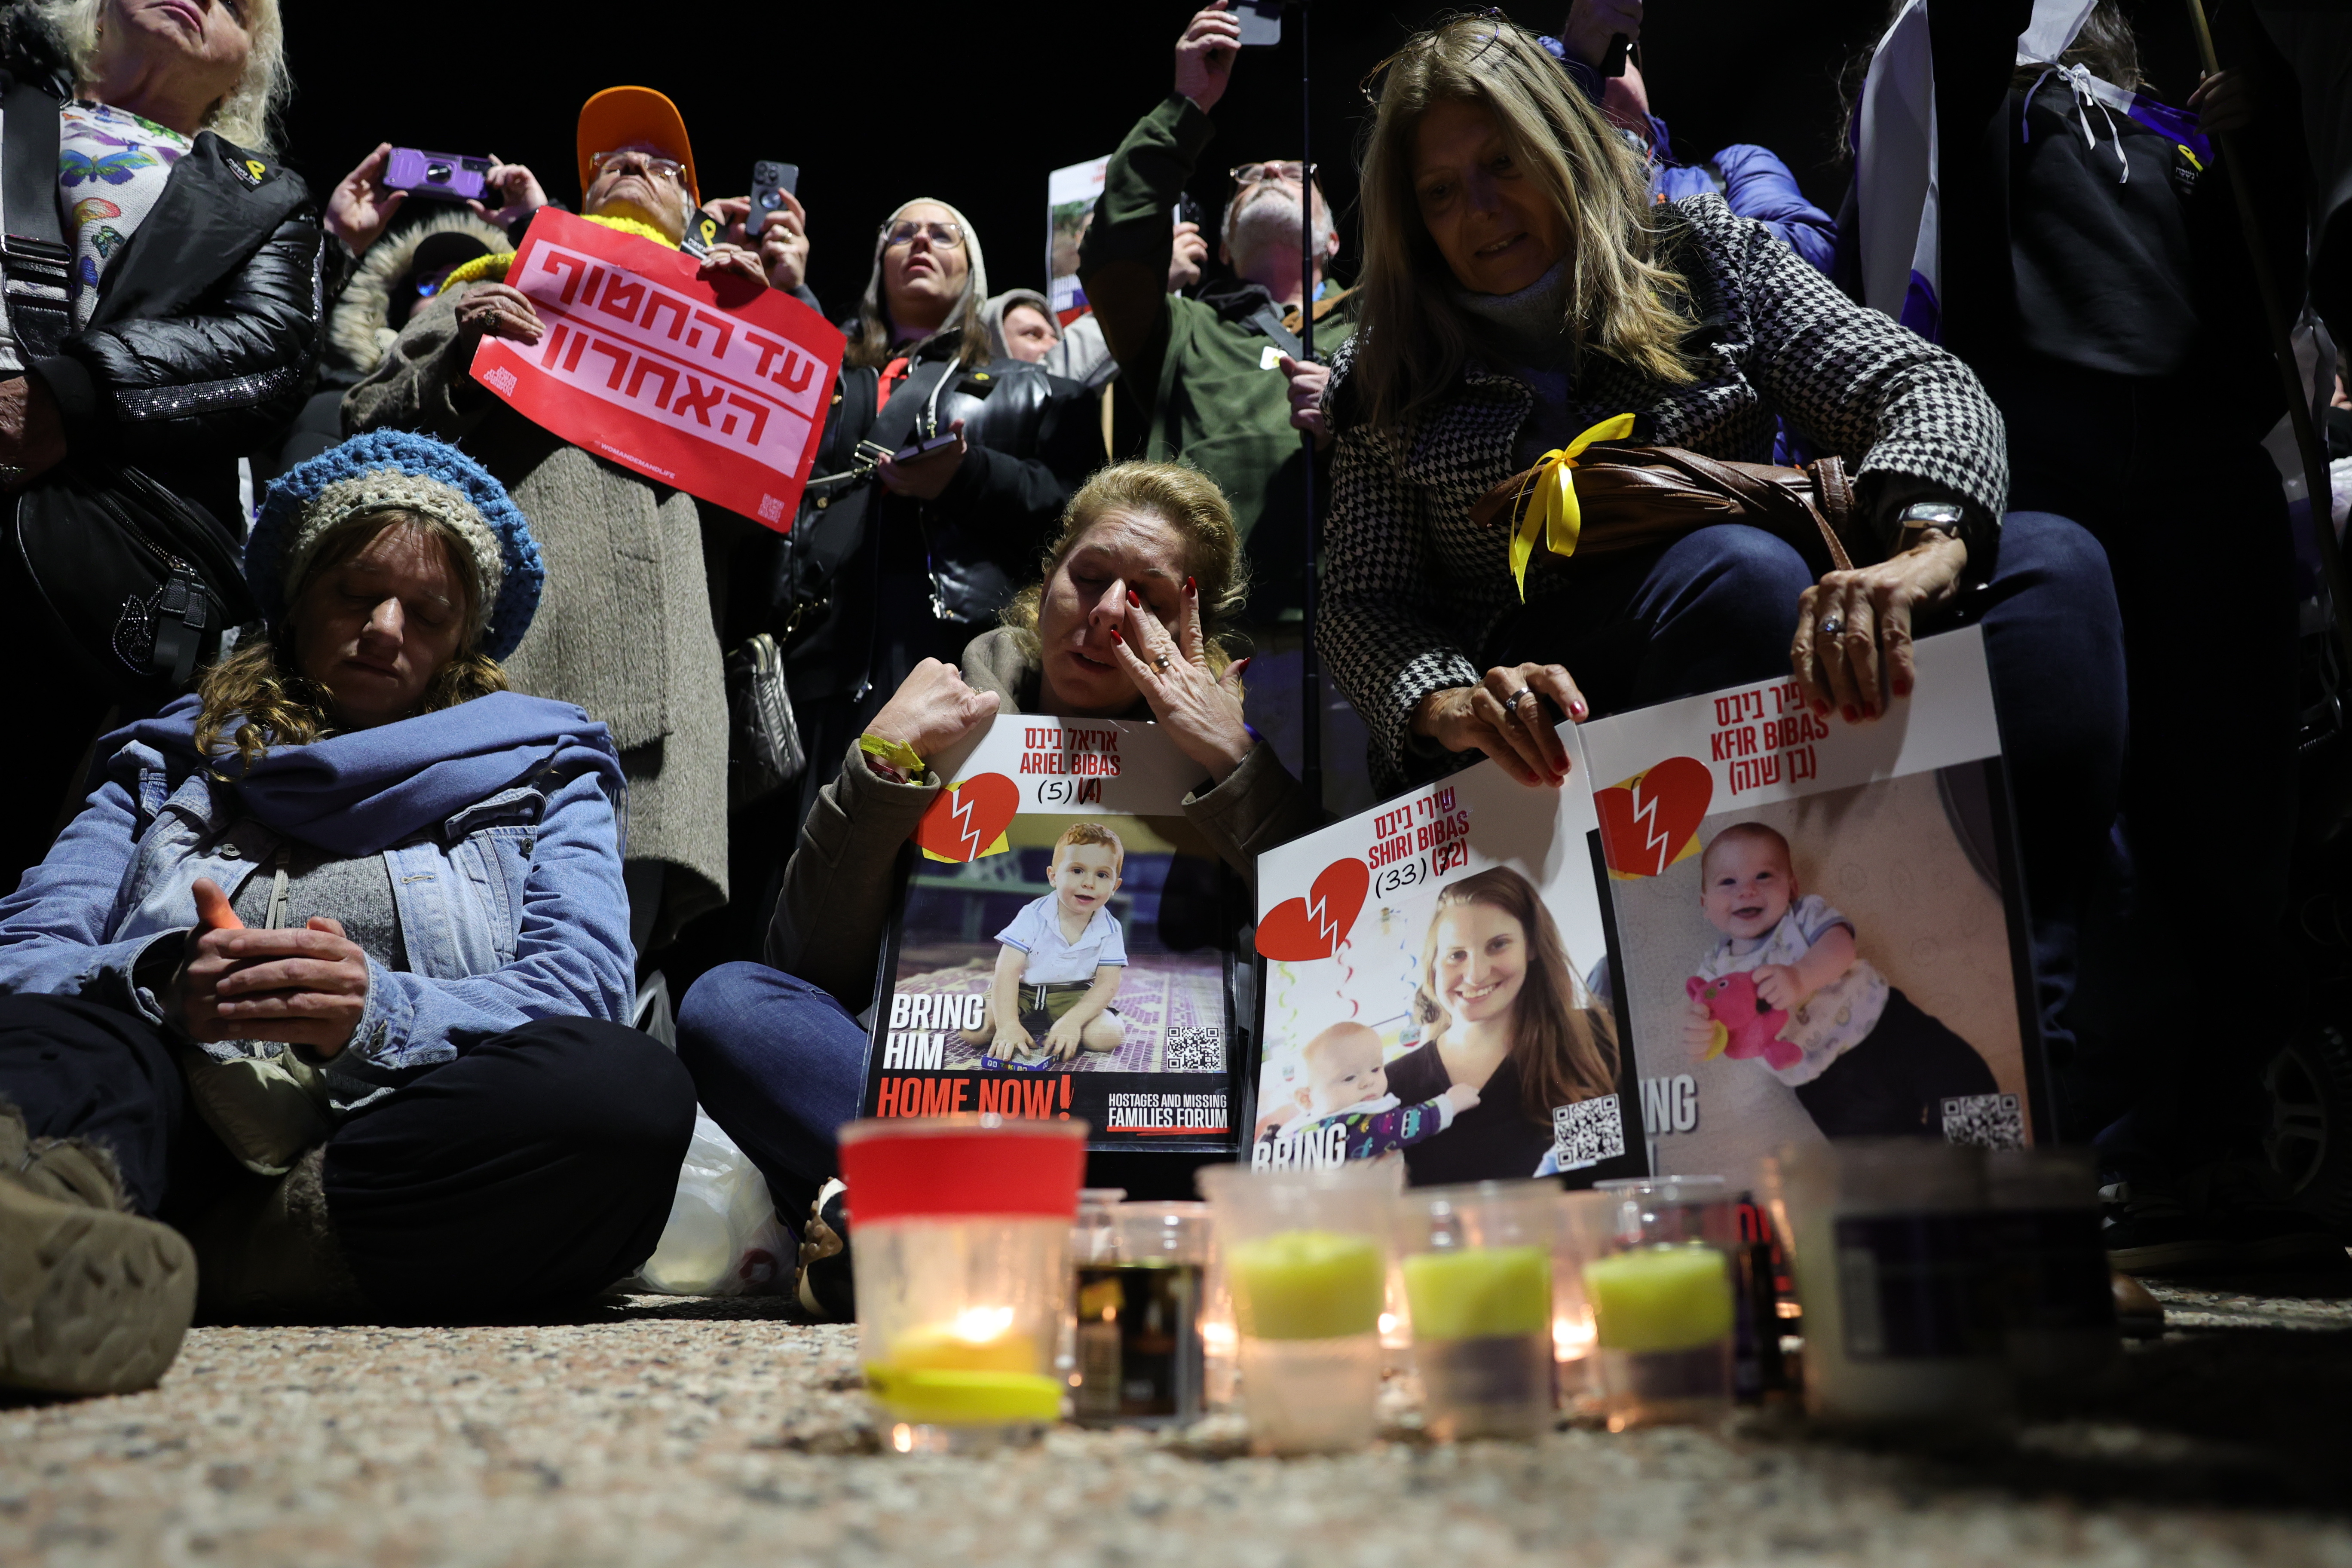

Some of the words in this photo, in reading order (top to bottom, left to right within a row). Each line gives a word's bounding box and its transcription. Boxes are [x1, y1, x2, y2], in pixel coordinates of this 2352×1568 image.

[542, 251, 735, 360] החטוף
[745, 331, 816, 394] עד
[541, 322, 771, 447] האחרון
[1714, 690, 1765, 726] ביבס
[1768, 681, 1806, 714] פיר
[1025, 727, 1063, 750] ביבס
[1068, 727, 1118, 752] אריאל
[1710, 726, 1758, 762] KFIR
[1763, 712, 1829, 751] BIBAS
[1019, 752, 1066, 774] ARIEL
[1071, 753, 1121, 776] BIBAS
[1038, 779, 1072, 805] (5)
[1416, 786, 1456, 819] שירי
[1368, 832, 1413, 870] SHIRI
[1417, 810, 1470, 851] BIBAS
[1374, 805, 1414, 840] ביבס
[1375, 857, 1427, 899] (33)
[888, 993, 985, 1030] BRING
[882, 1032, 946, 1070] HIM
[876, 1077, 971, 1118] HOME
[1109, 1093, 1159, 1107] HOSTAGES
[1161, 1094, 1181, 1108] AND
[1183, 1094, 1227, 1108] MISSING
[1109, 1107, 1173, 1128] FAMILIES
[1176, 1108, 1228, 1129] FORUM
[1250, 1122, 1347, 1174] BRING
